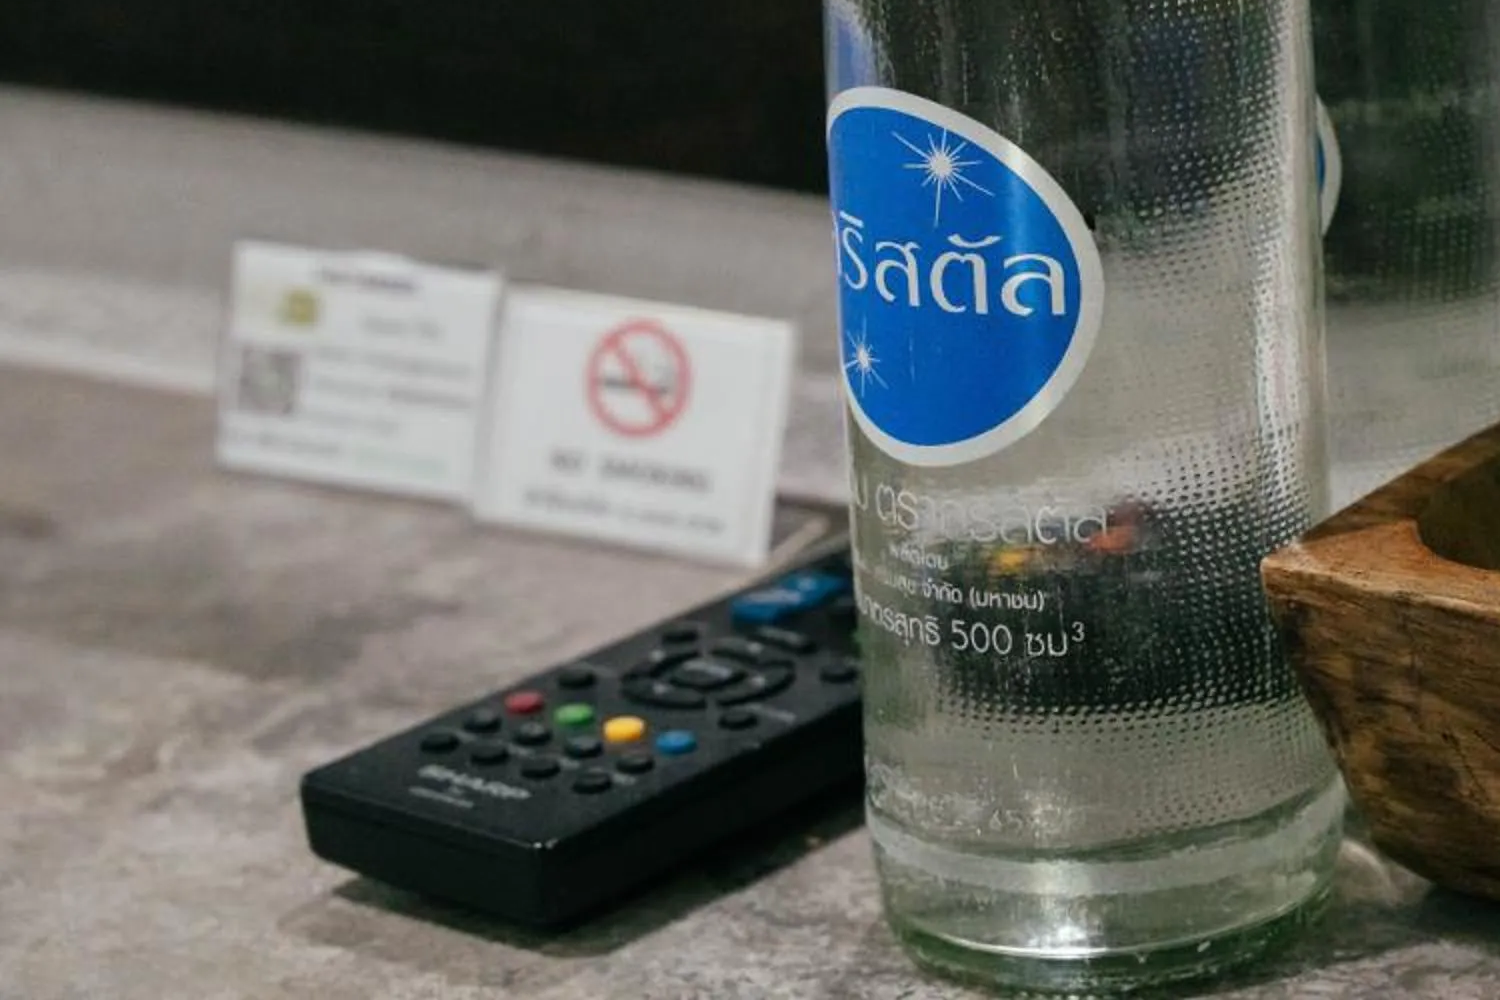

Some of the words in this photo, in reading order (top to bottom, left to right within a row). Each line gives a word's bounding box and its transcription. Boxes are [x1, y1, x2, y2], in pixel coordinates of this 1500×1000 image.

[834, 210, 1067, 318] ริสตัล
[950, 618, 1013, 656] 500
